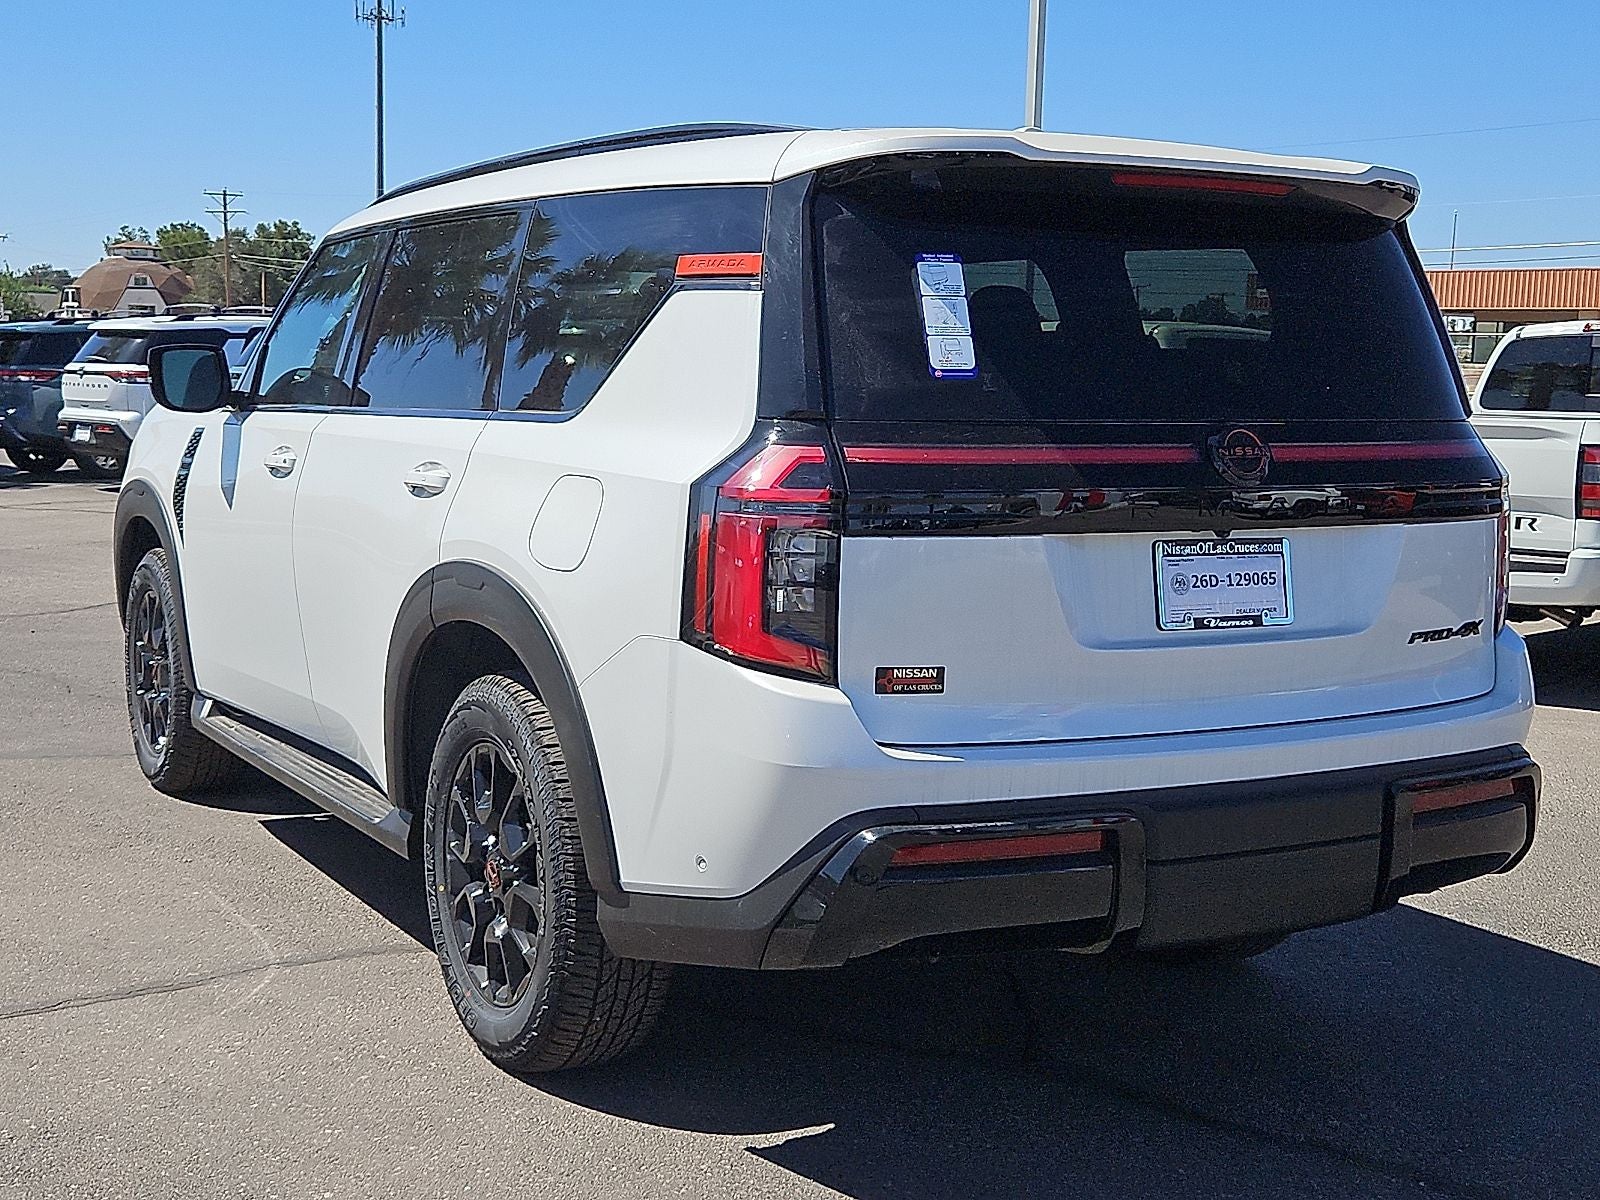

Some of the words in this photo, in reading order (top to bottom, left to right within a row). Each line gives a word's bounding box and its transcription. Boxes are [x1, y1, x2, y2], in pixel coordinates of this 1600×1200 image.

[688, 259, 745, 268] ARMADA
[1218, 446, 1267, 456] NISSAN
[1163, 541, 1283, 556] NissanOfLasCruces.com
[1190, 571, 1278, 589] 26D-129065
[1203, 618, 1254, 628] Vamos
[1407, 618, 1484, 645] PRO-4X
[893, 668, 938, 679] NISSAN
[917, 683, 943, 691] CRUCES
